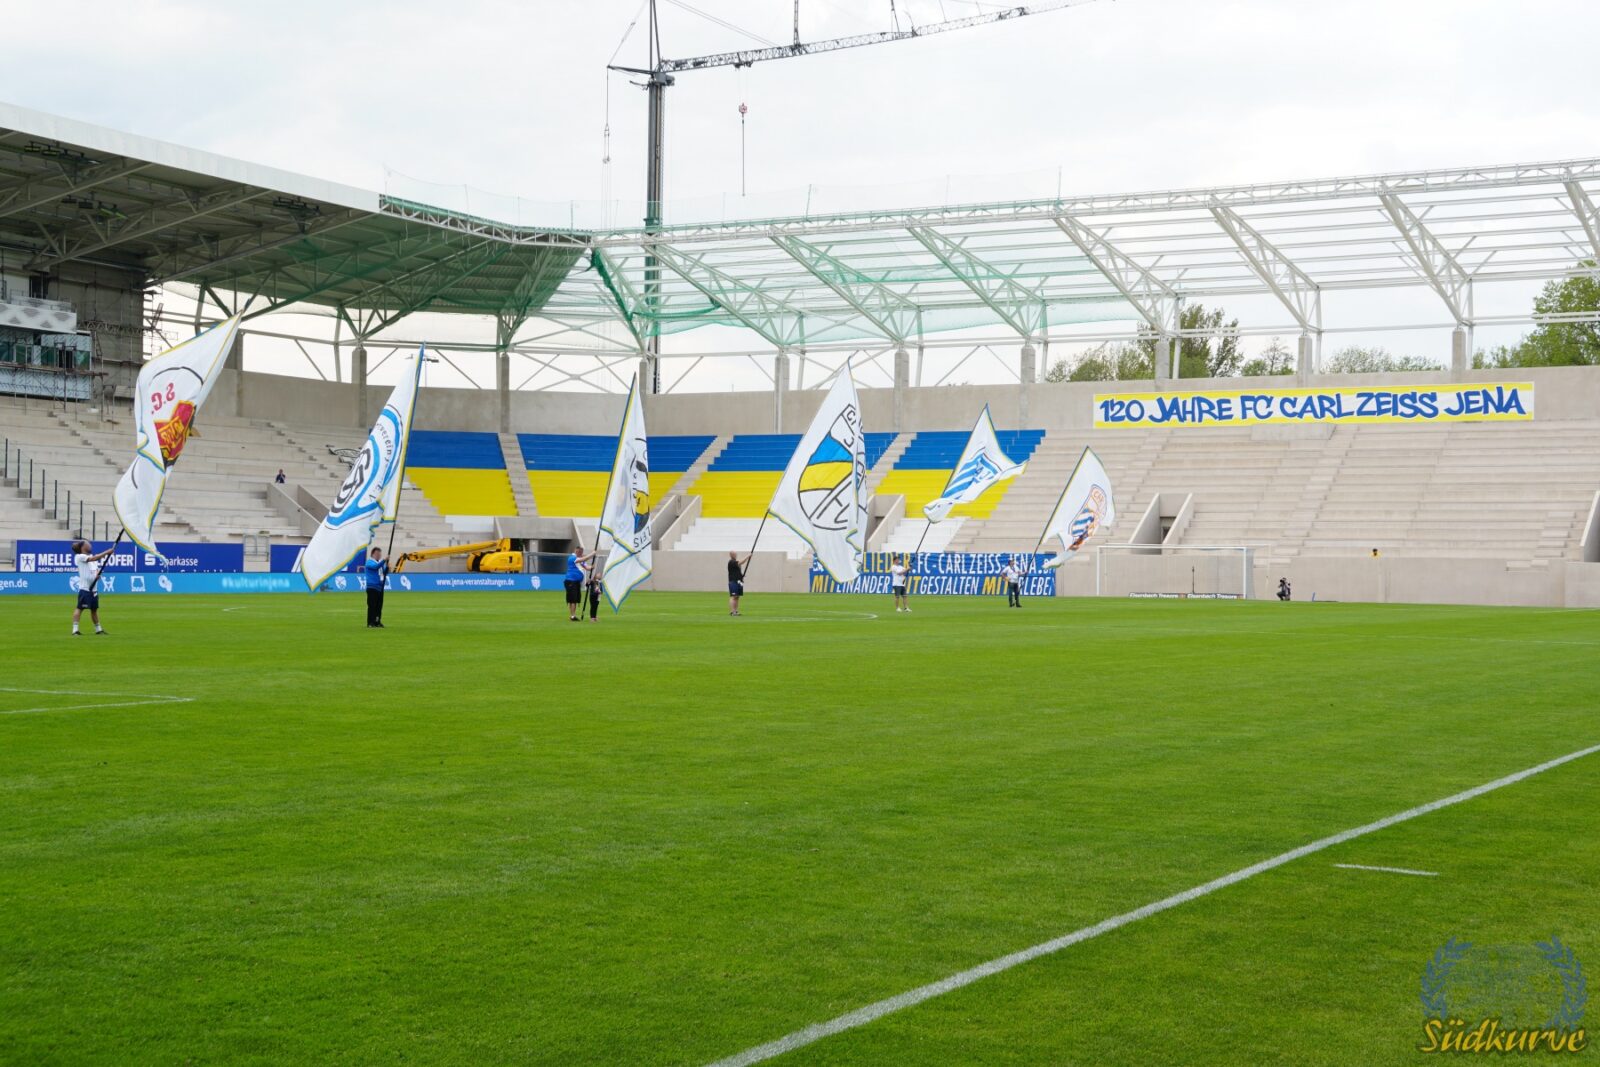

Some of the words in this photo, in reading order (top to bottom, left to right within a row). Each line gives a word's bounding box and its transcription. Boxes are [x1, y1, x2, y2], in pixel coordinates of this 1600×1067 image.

[1100, 398, 1143, 423] 120
[1149, 395, 1234, 423] JAHRE
[1240, 395, 1275, 420] FC
[1279, 393, 1354, 419] CARL
[1356, 391, 1440, 418] ZEISS
[1443, 385, 1526, 416] JENA
[37, 553, 72, 566] MELLE
